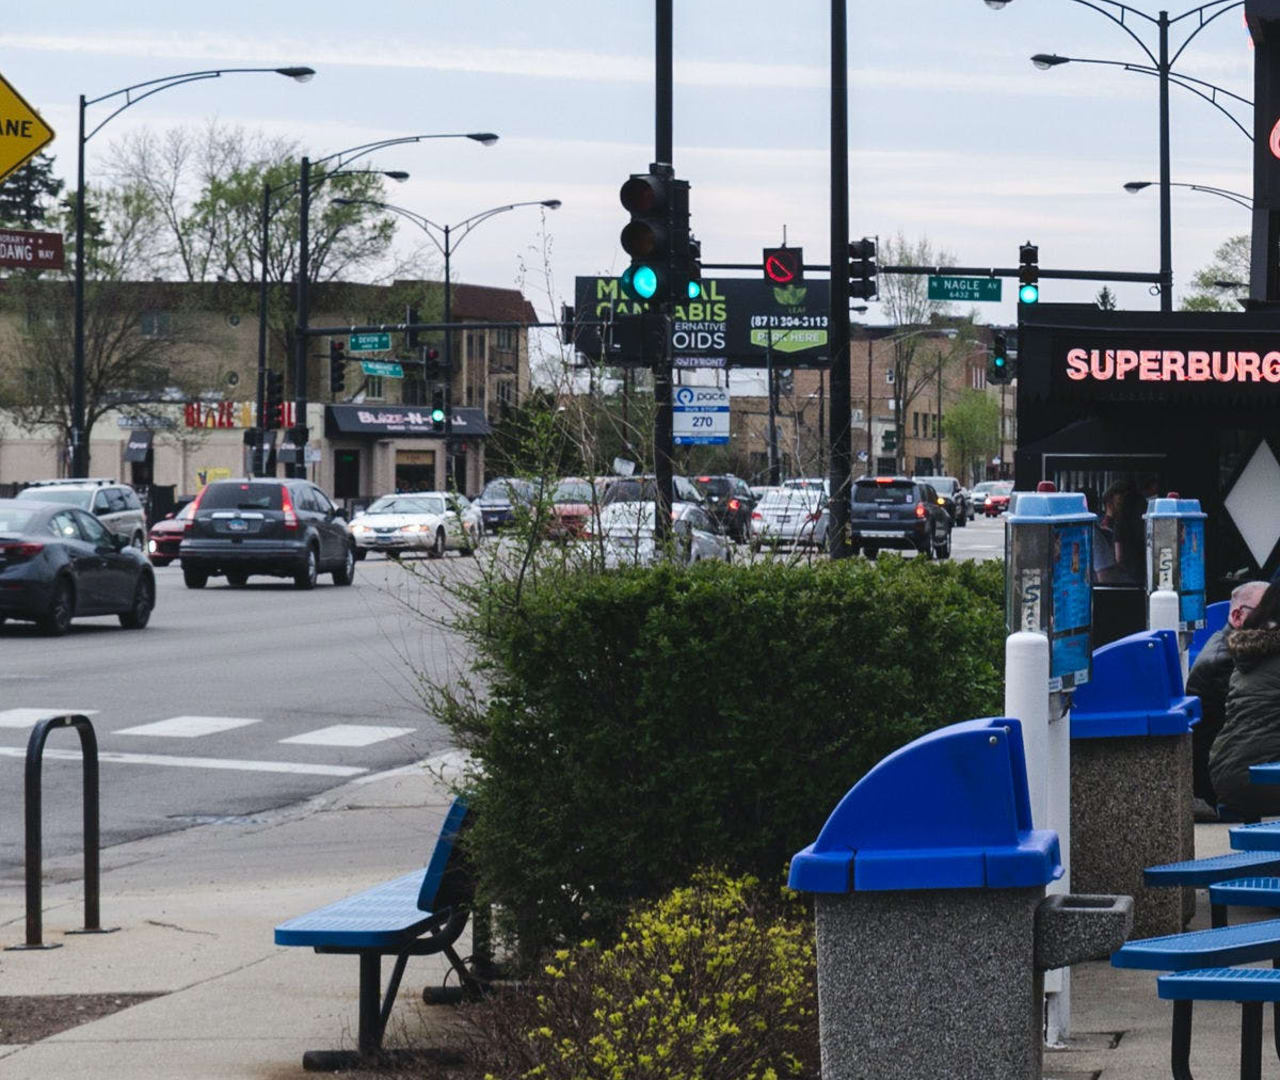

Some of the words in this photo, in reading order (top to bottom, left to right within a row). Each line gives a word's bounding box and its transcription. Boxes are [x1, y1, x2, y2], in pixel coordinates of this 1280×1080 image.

[944, 280, 980, 291] NAGLE
[987, 282, 998, 290] AV
[675, 322, 727, 332] ERNATIVE
[672, 331, 726, 350] OIDS
[697, 393, 726, 402] pace
[692, 416, 714, 428] 270
